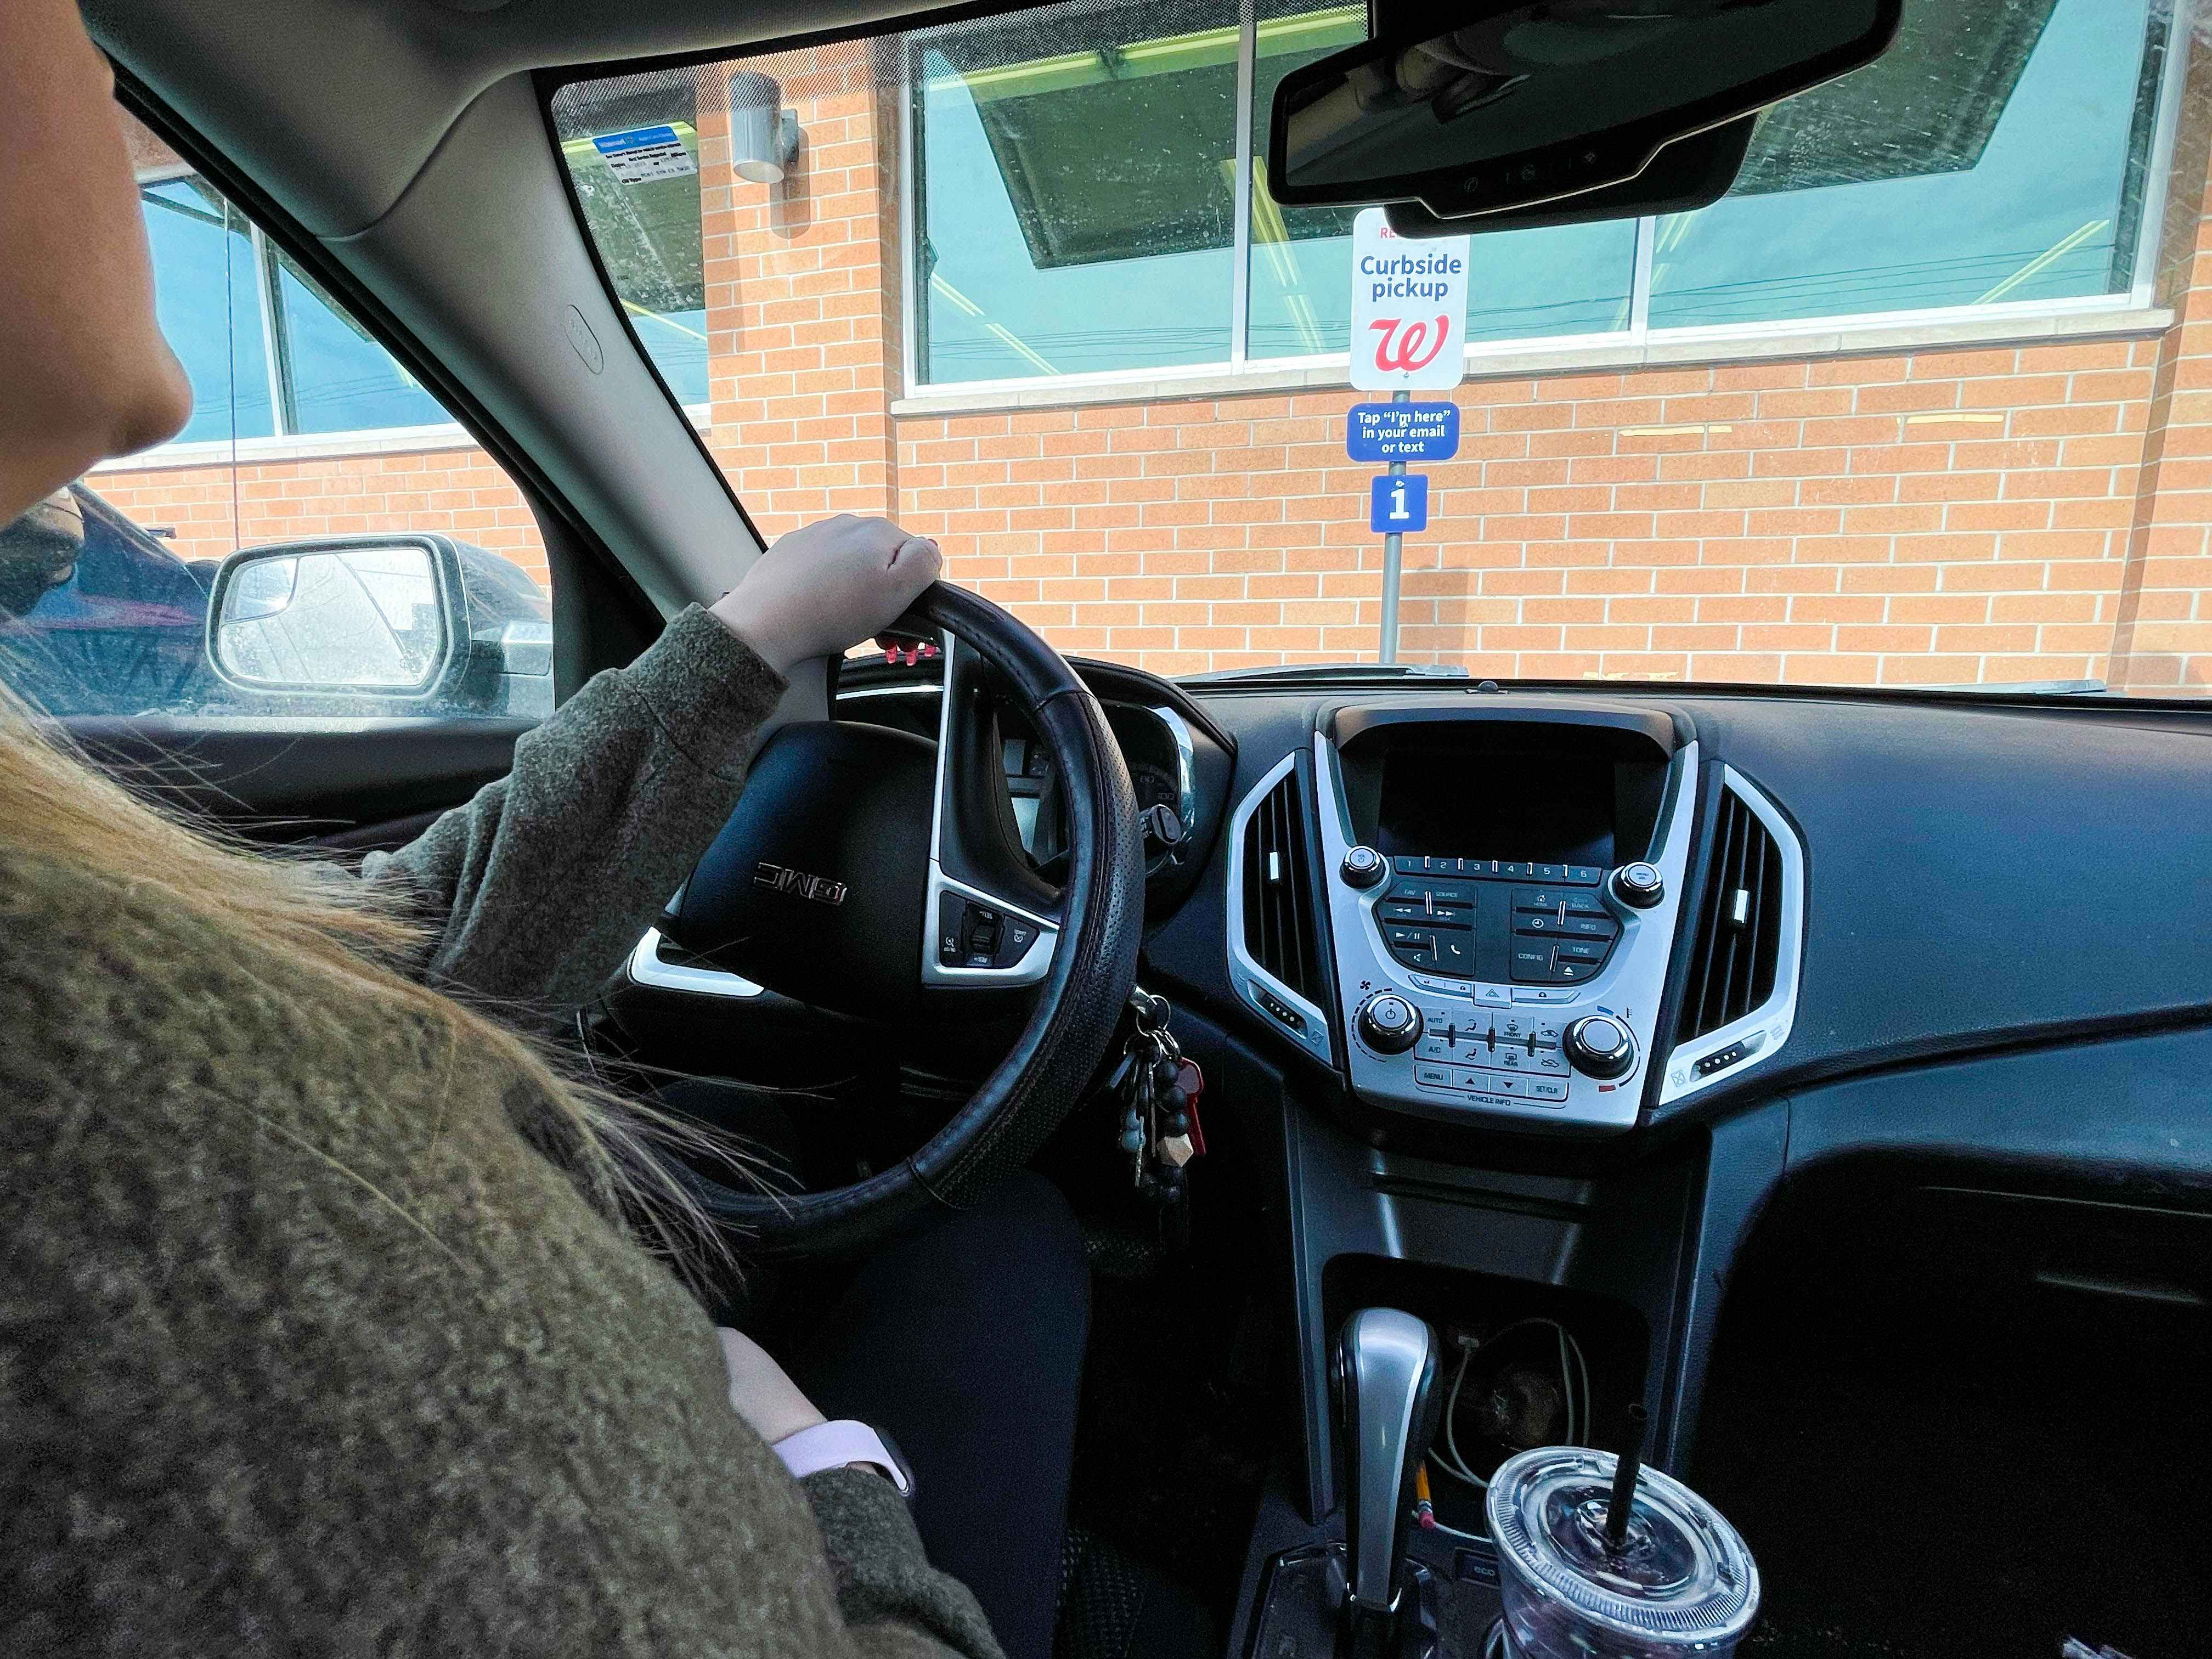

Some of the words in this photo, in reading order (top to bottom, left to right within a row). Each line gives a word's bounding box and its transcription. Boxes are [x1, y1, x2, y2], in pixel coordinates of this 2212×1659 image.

[1361, 254, 1462, 275] Curbside
[1372, 277, 1449, 302] pickup
[1357, 411, 1381, 426] Tap
[1362, 426, 1375, 439] in
[1378, 427, 1408, 440] your
[1409, 425, 1445, 438] email
[1381, 443, 1396, 453] or
[1398, 441, 1425, 453] text
[1408, 860, 1412, 868] 1
[1573, 946, 1590, 955] TONE
[1518, 952, 1544, 962] CONFIG
[1424, 1072, 1444, 1081] MENU
[1536, 1085, 1558, 1094] SET/CLR
[1466, 1094, 1496, 1104] VEHICLE
